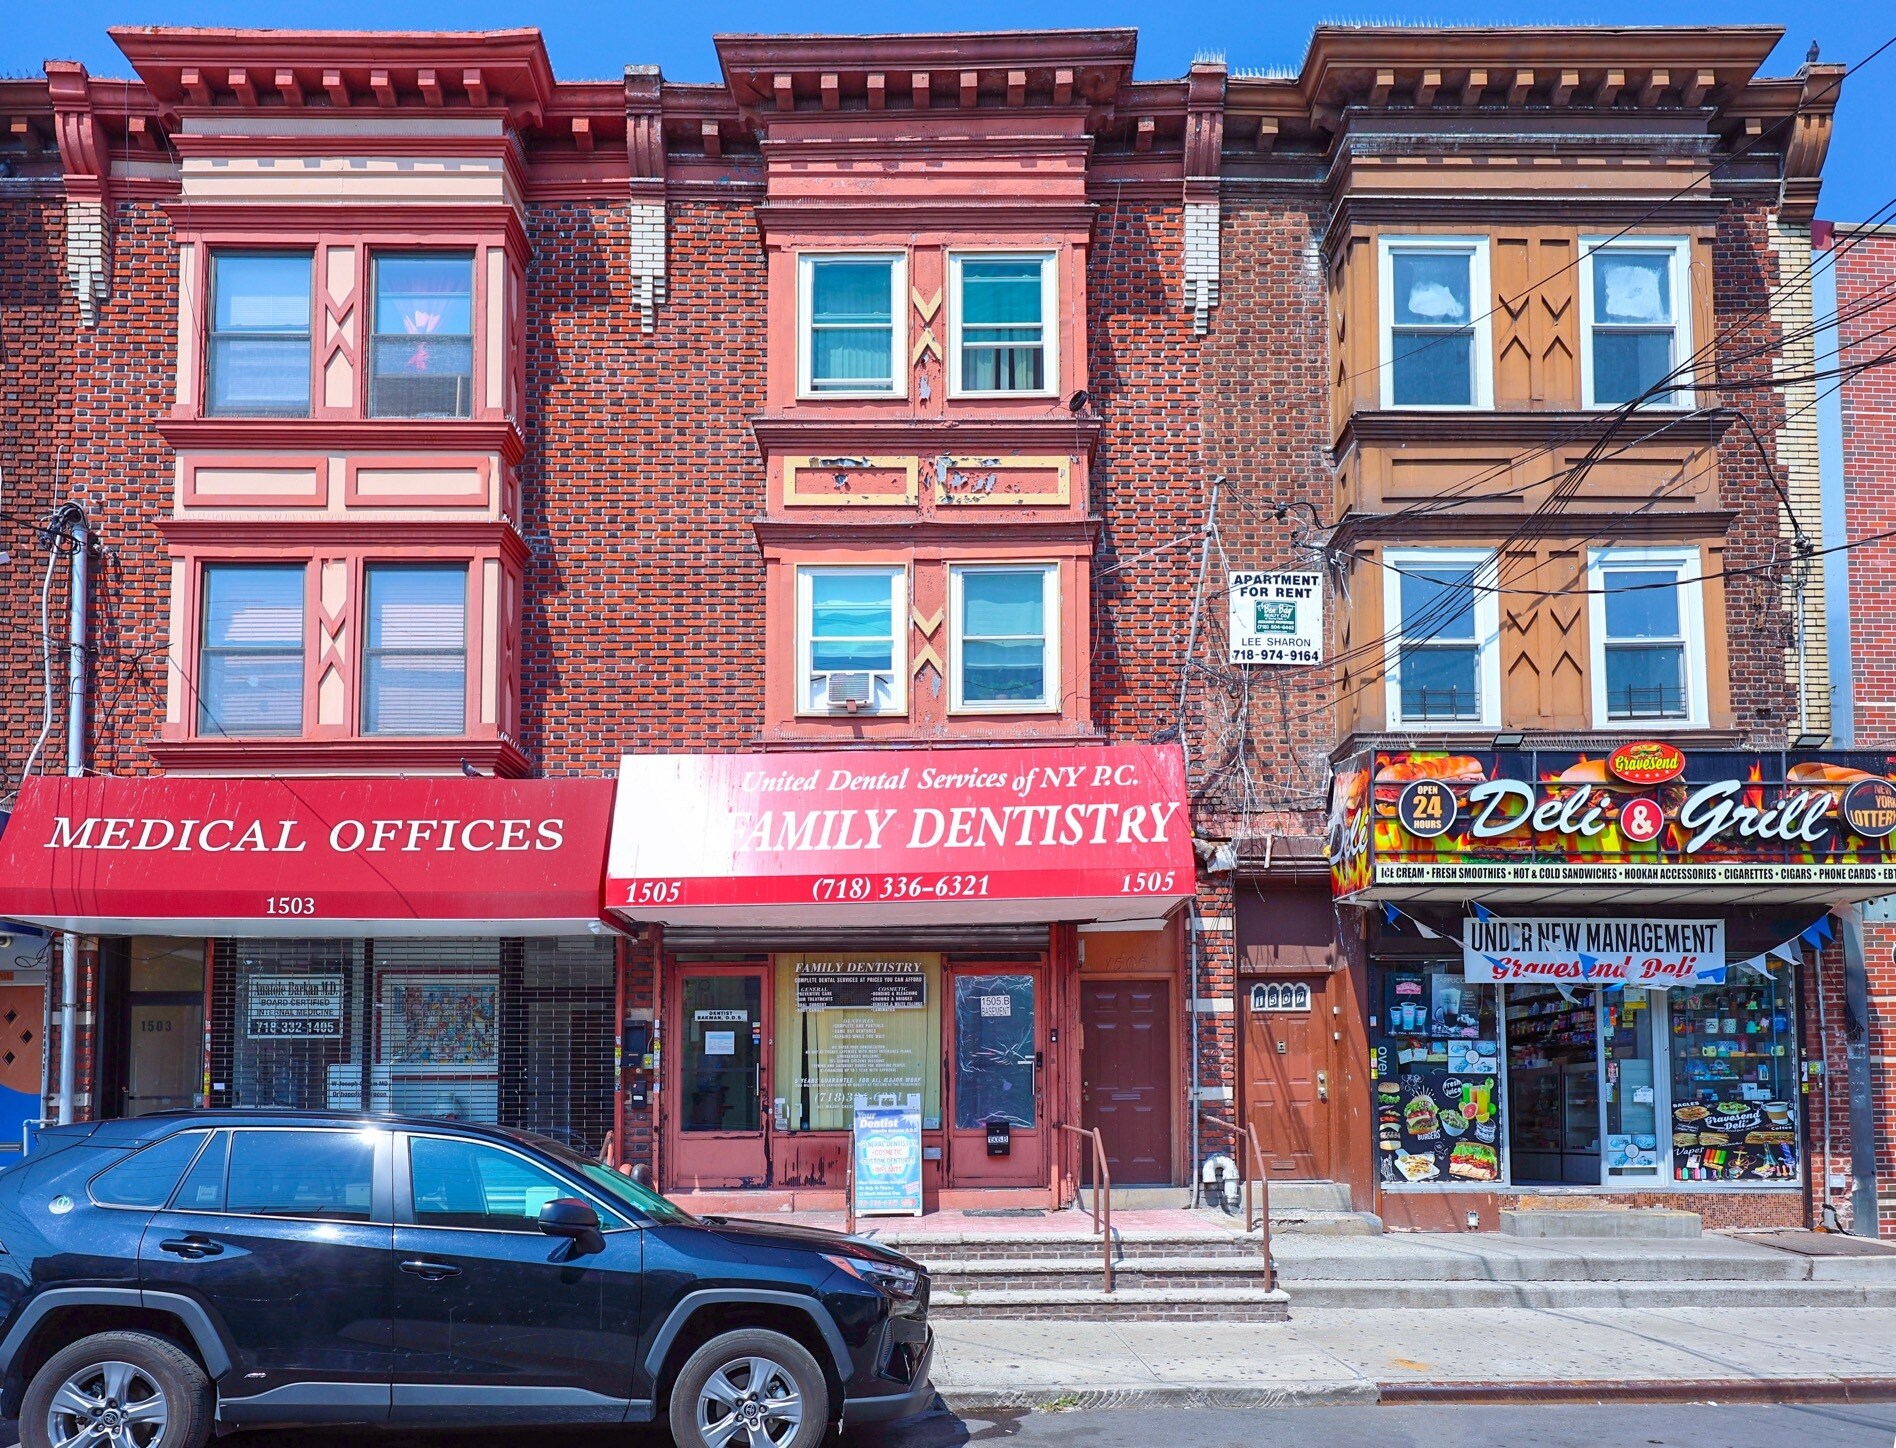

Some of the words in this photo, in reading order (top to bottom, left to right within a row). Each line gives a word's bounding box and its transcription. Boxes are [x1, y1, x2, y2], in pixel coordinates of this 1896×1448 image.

[1234, 575, 1319, 586] APARTMENT
[1240, 587, 1268, 597] FOR
[1276, 588, 1312, 598] RENT
[1242, 638, 1261, 647] LEE
[1267, 638, 1311, 647] SHARON
[1233, 650, 1319, 661] 718-974-9164
[1615, 754, 1679, 772] Gravesend
[742, 769, 818, 794] United
[826, 767, 908, 793] Dental
[917, 767, 1007, 790] Services
[1011, 765, 1035, 797] of
[1039, 766, 1085, 788] NY
[1089, 764, 1139, 788] P.C.
[1418, 785, 1438, 795] OPEN
[1874, 784, 1892, 795] NEW
[1412, 796, 1442, 818] 24
[1470, 778, 1610, 838] Deli
[1630, 805, 1653, 835] &
[1681, 779, 1831, 853] Grill
[728, 808, 900, 853] FAMILY
[907, 801, 1180, 850] DENTISTRY
[1413, 820, 1442, 829] HOURS
[44, 817, 306, 852] MEDICAL
[329, 818, 565, 852] OFFICES
[1329, 808, 1369, 866] Deli
[1381, 867, 1394, 878] ICE
[1396, 867, 1424, 879] CREAM
[1432, 867, 1456, 879] FRESH
[1458, 867, 1506, 879] SMOOTHIES
[1513, 867, 1529, 879] HOT
[1531, 868, 1538, 879] &
[1539, 867, 1561, 879] COLD
[1562, 867, 1617, 880] SANDWICHES
[1624, 867, 1658, 880] HOOKAH
[1660, 867, 1717, 880] ACCESSORIES
[1724, 867, 1773, 880] CIGARETTES
[1780, 867, 1812, 880] CIGARS
[1819, 867, 1846, 880] PHONE
[1848, 867, 1876, 880] CARDS
[625, 881, 682, 905] 1505
[812, 875, 872, 902] (718)
[880, 873, 990, 899] 336-6321
[1121, 871, 1175, 894] 1505
[266, 897, 315, 915] 1503
[1537, 922, 1581, 952] NEW
[1586, 922, 1718, 953] MANAGEMENT
[795, 962, 844, 973] FAMILY
[846, 962, 923, 973] DENTISTRY
[1106, 956, 1150, 971] 1505
[254, 982, 286, 995] Anatole
[288, 982, 319, 995] Barkan
[1256, 993, 1305, 1008] 1507
[982, 1006, 1010, 1015] BASEMENT
[141, 1020, 172, 1032] 1503
[255, 1021, 334, 1033] 718-332-1405
[1444, 1079, 1462, 1088] Fresh
[857, 1111, 876, 1119] Your
[1705, 1110, 1760, 1124] Gravesend
[860, 1118, 898, 1128] Dentist
[1724, 1119, 1746, 1130] Deli
[1417, 1130, 1440, 1141] BURGERS
